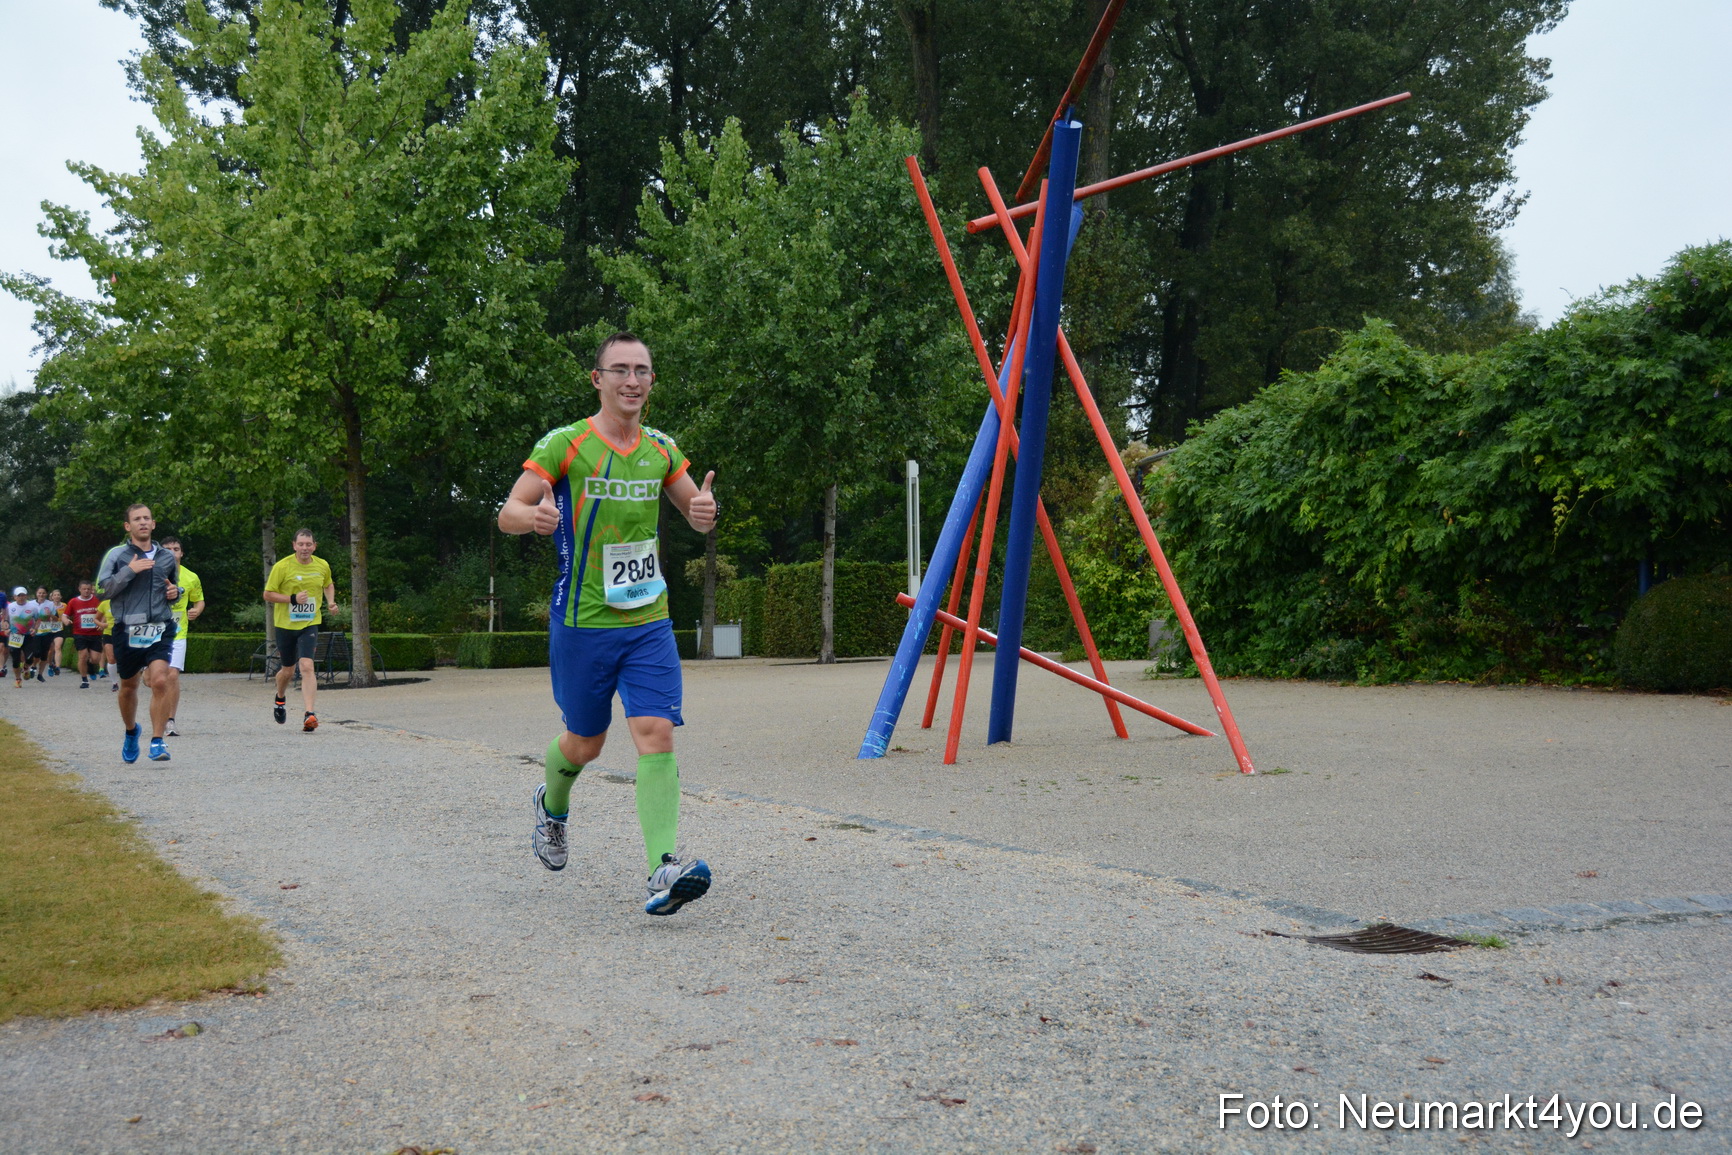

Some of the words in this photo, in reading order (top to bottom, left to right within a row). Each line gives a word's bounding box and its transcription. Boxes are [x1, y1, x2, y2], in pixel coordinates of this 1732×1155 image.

[585, 477, 662, 501] BOCK
[627, 588, 649, 599] Tobias
[292, 603, 315, 613] 2020
